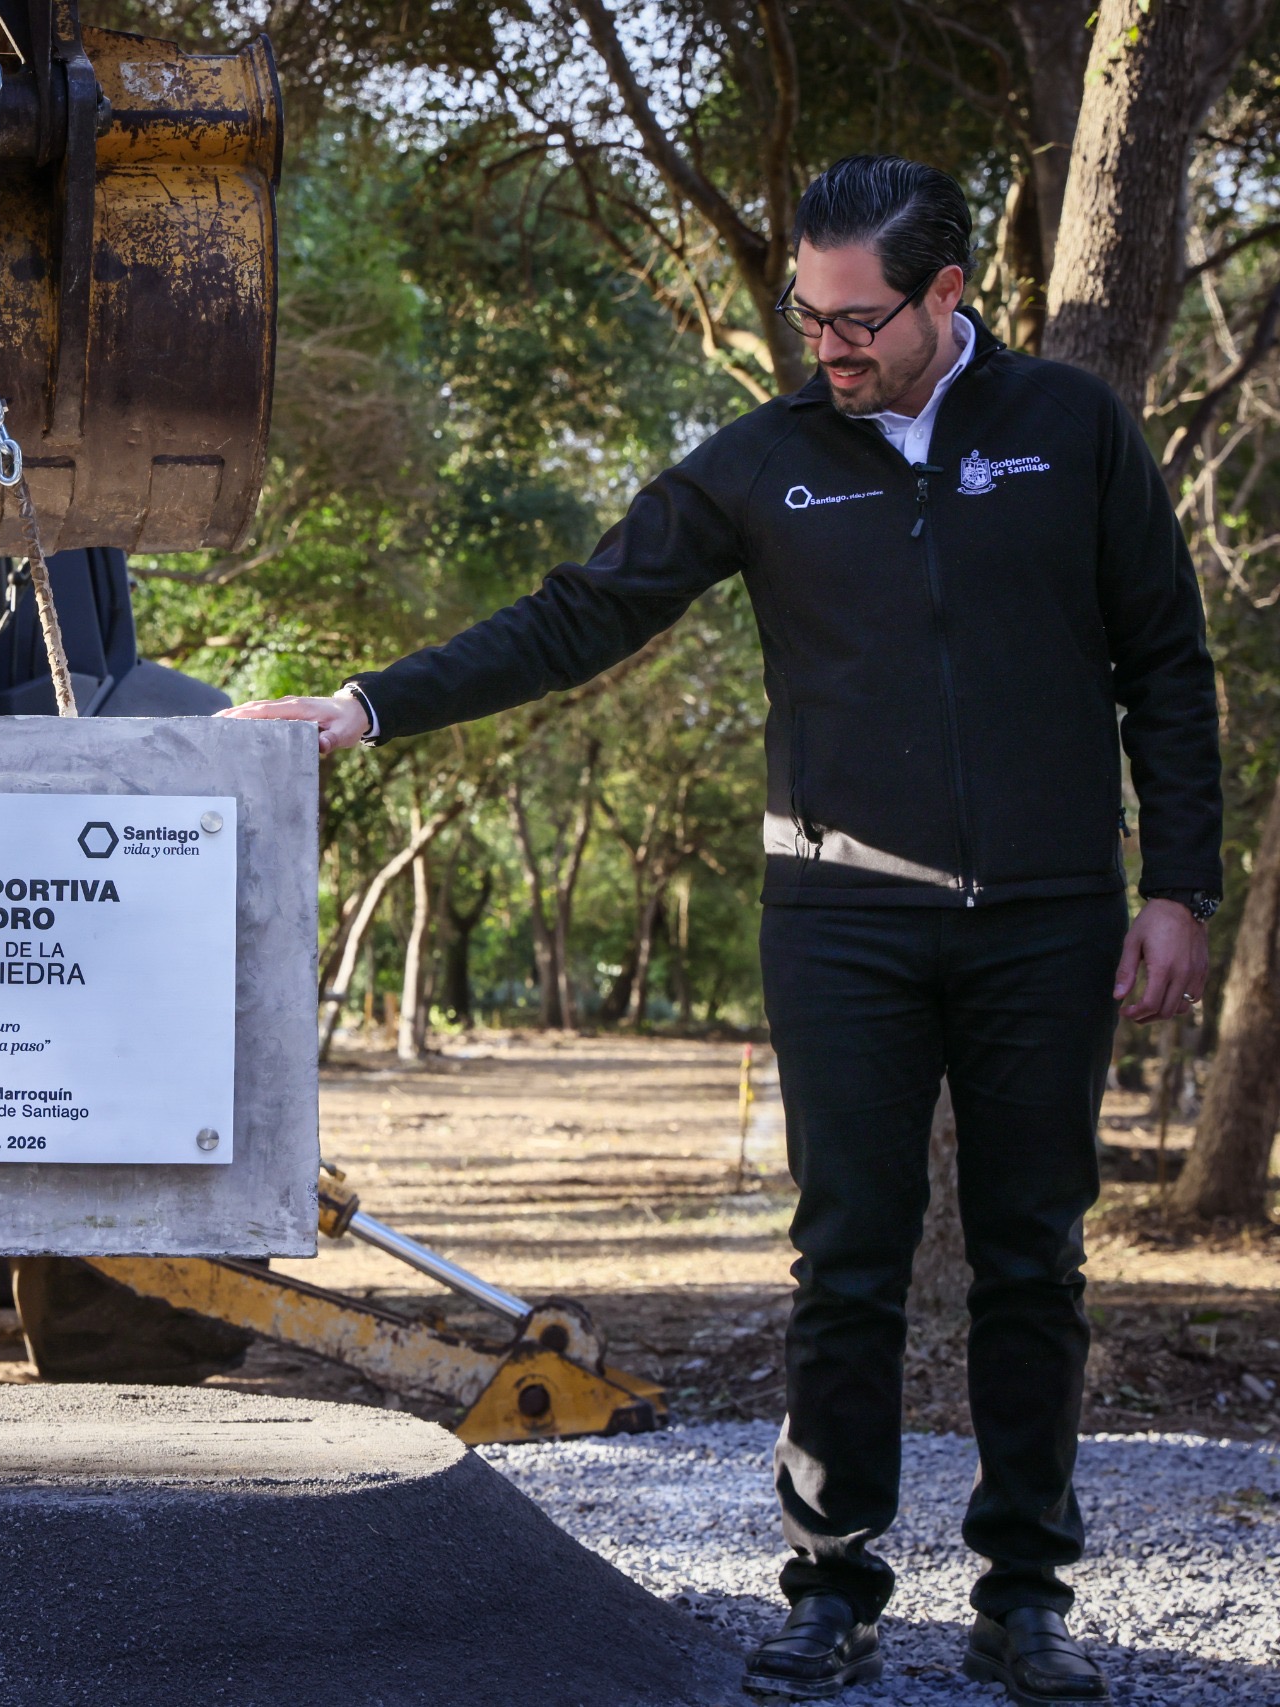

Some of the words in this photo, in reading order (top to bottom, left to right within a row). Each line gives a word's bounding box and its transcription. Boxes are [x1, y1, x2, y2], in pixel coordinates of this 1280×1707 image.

[990, 456, 1041, 470] Gobierno
[992, 469, 1005, 477] de
[1007, 463, 1050, 474] Santiago
[123, 826, 200, 843] Santiago
[124, 844, 150, 855] vida
[151, 847, 161, 858] y
[163, 844, 200, 856] orden
[6, 942, 32, 958] DE
[39, 942, 65, 959] LA
[0, 1043, 8, 1052] a
[21, 1104, 89, 1121] Santiago
[7, 1136, 47, 1150] 2026
